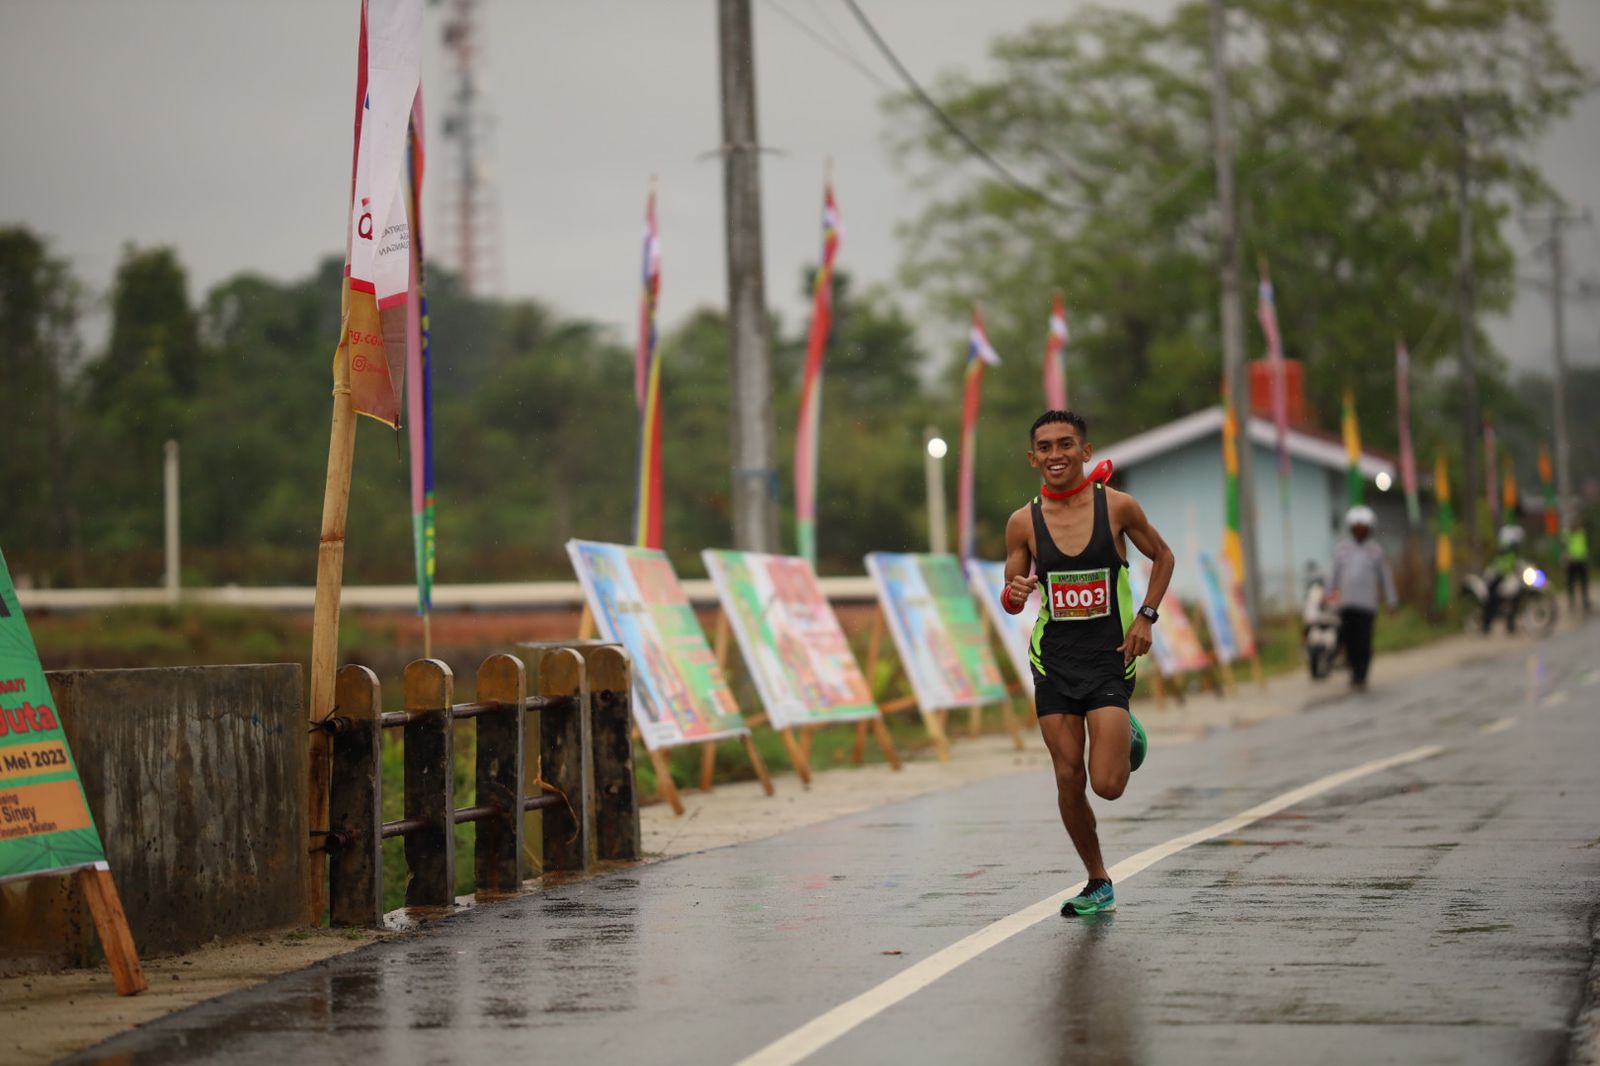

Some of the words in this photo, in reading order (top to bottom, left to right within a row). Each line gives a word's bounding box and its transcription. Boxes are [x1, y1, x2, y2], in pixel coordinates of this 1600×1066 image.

[1054, 588, 1105, 608] 1003
[3, 751, 32, 771] Mei
[32, 748, 66, 768] 2023
[2, 806, 36, 823] Siney
